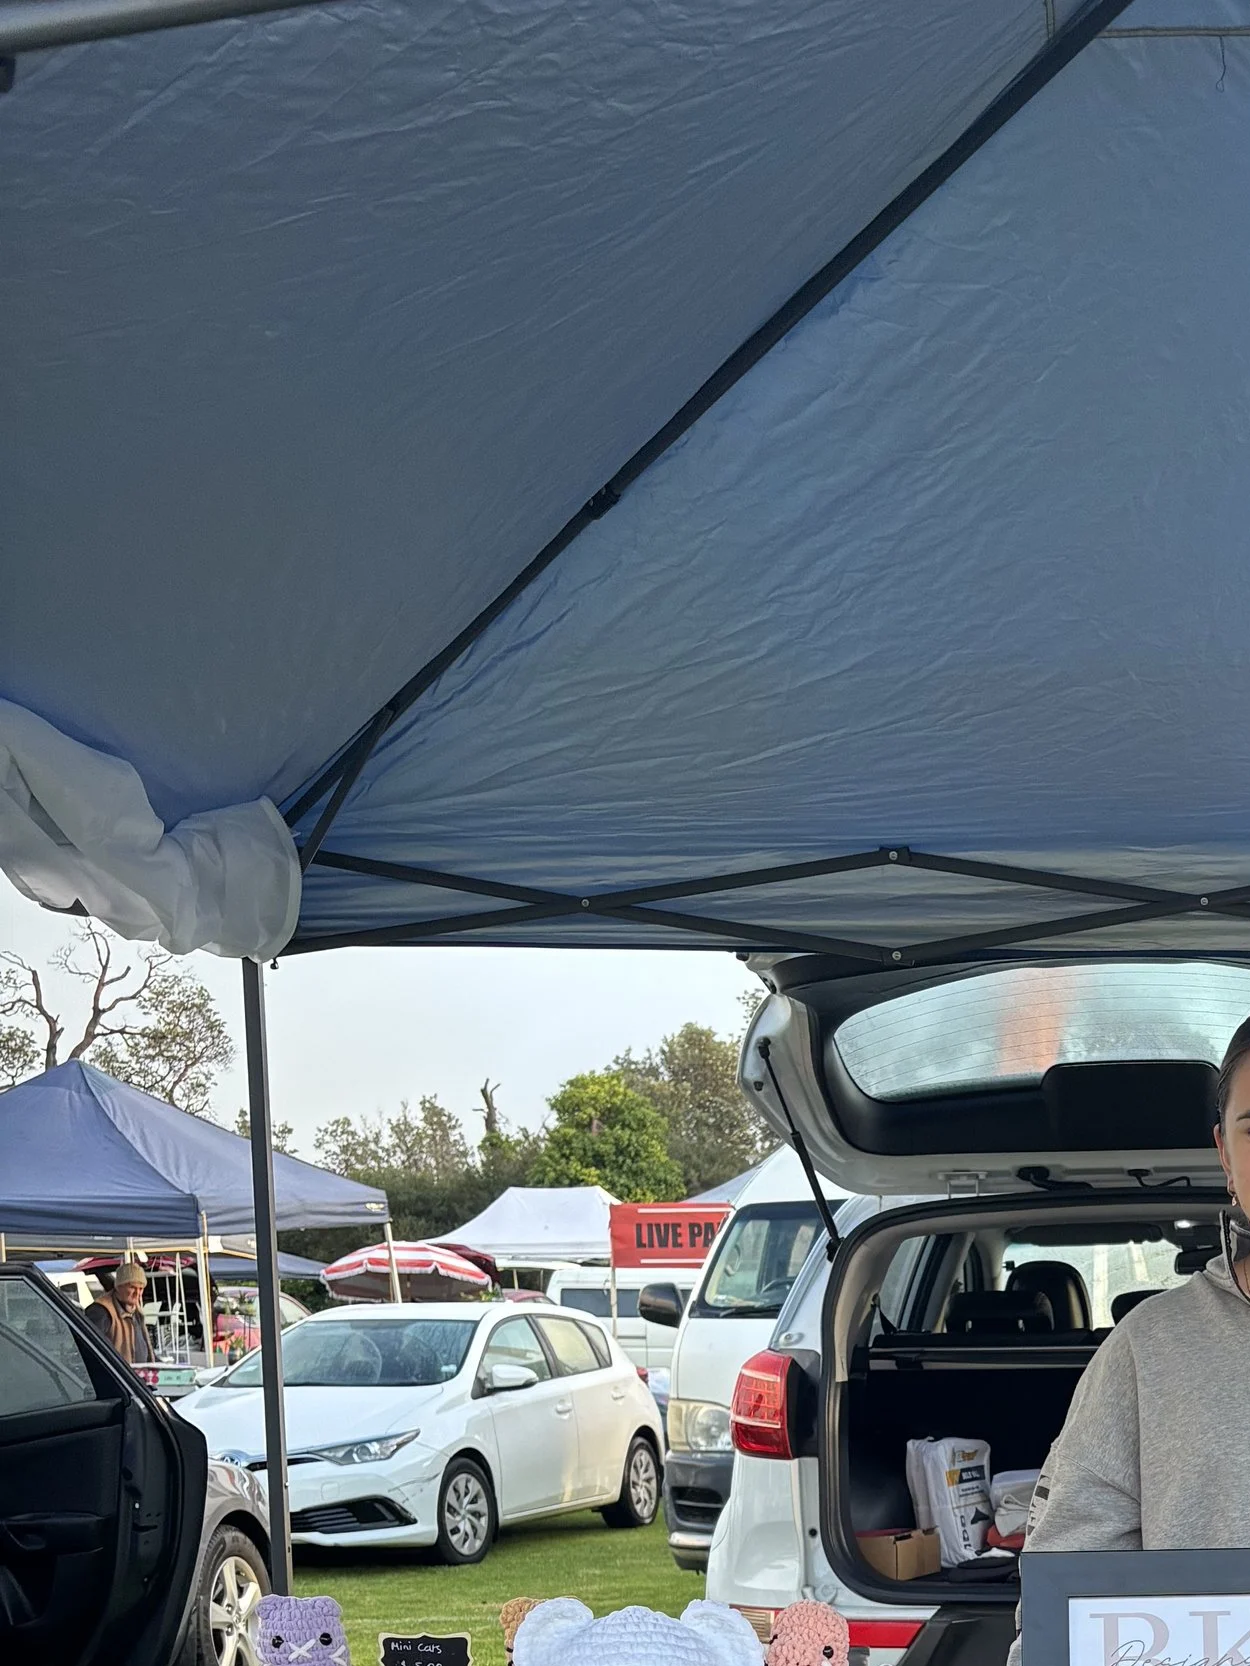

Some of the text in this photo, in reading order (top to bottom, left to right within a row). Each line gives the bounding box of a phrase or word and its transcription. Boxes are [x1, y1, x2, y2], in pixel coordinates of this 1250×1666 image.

[636, 1222, 720, 1248] LIVE PA
[391, 1641, 442, 1654] Mini Cats
